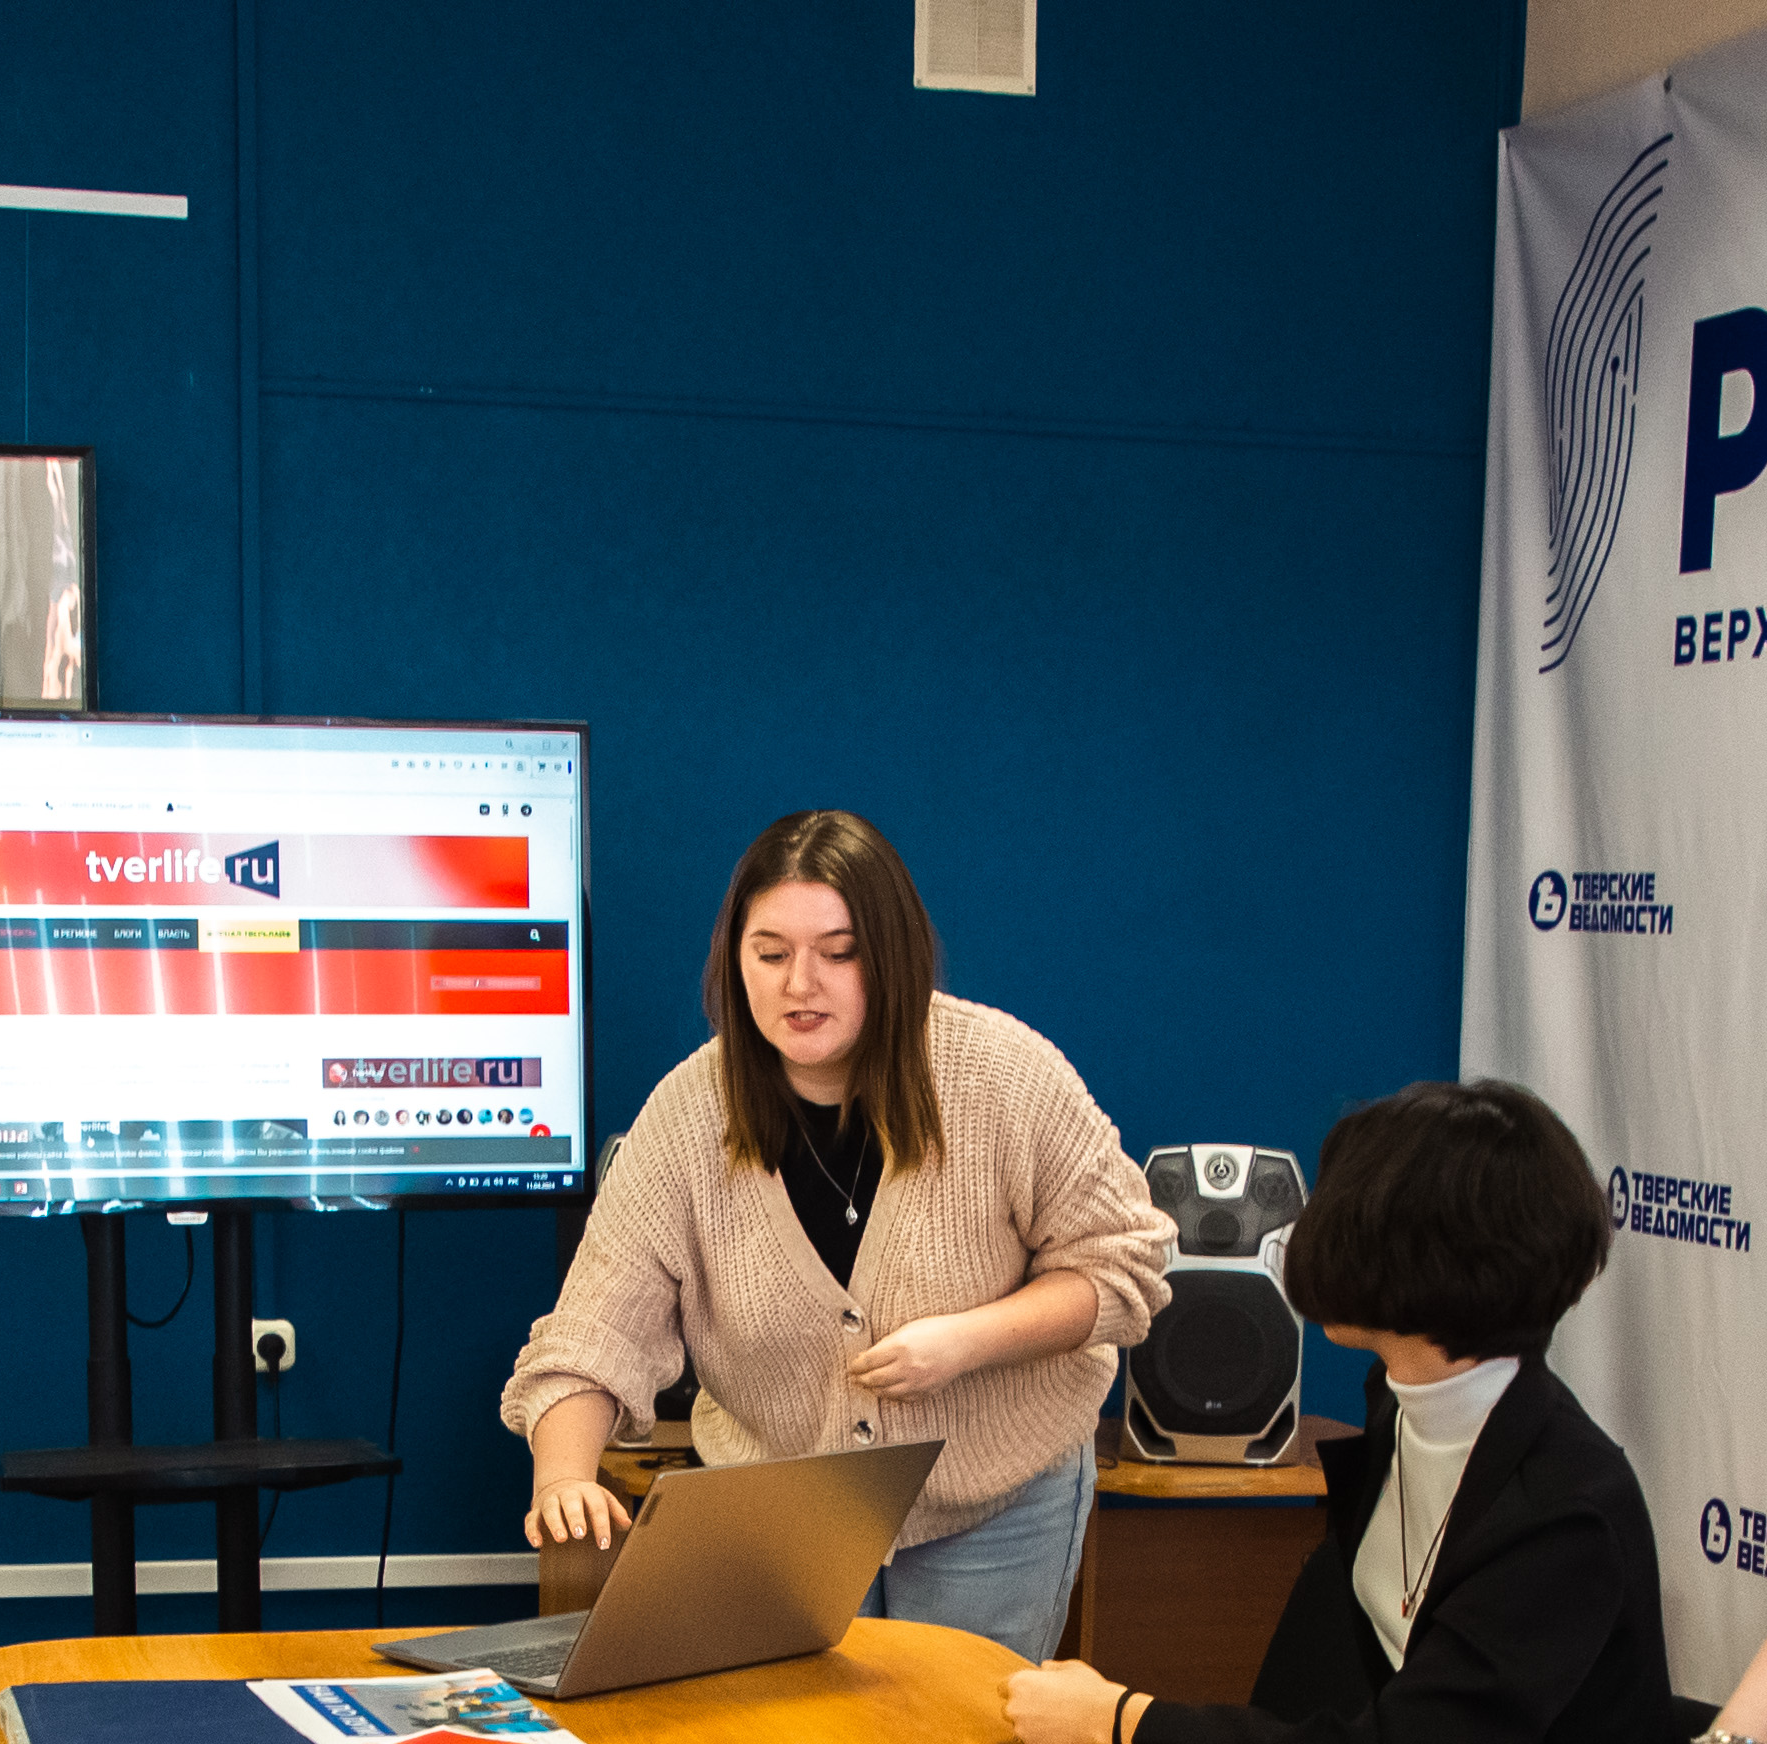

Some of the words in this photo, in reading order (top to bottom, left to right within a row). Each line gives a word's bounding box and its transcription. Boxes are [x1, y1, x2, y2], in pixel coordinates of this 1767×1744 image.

[1571, 872, 1656, 902] ТВЕРСКИЕ
[1568, 903, 1674, 935] ВЕДОМОСТИ
[1631, 1172, 1732, 1216] ТВЕРСКИЕ
[1630, 1202, 1751, 1252] ВЕДОМОСТИ
